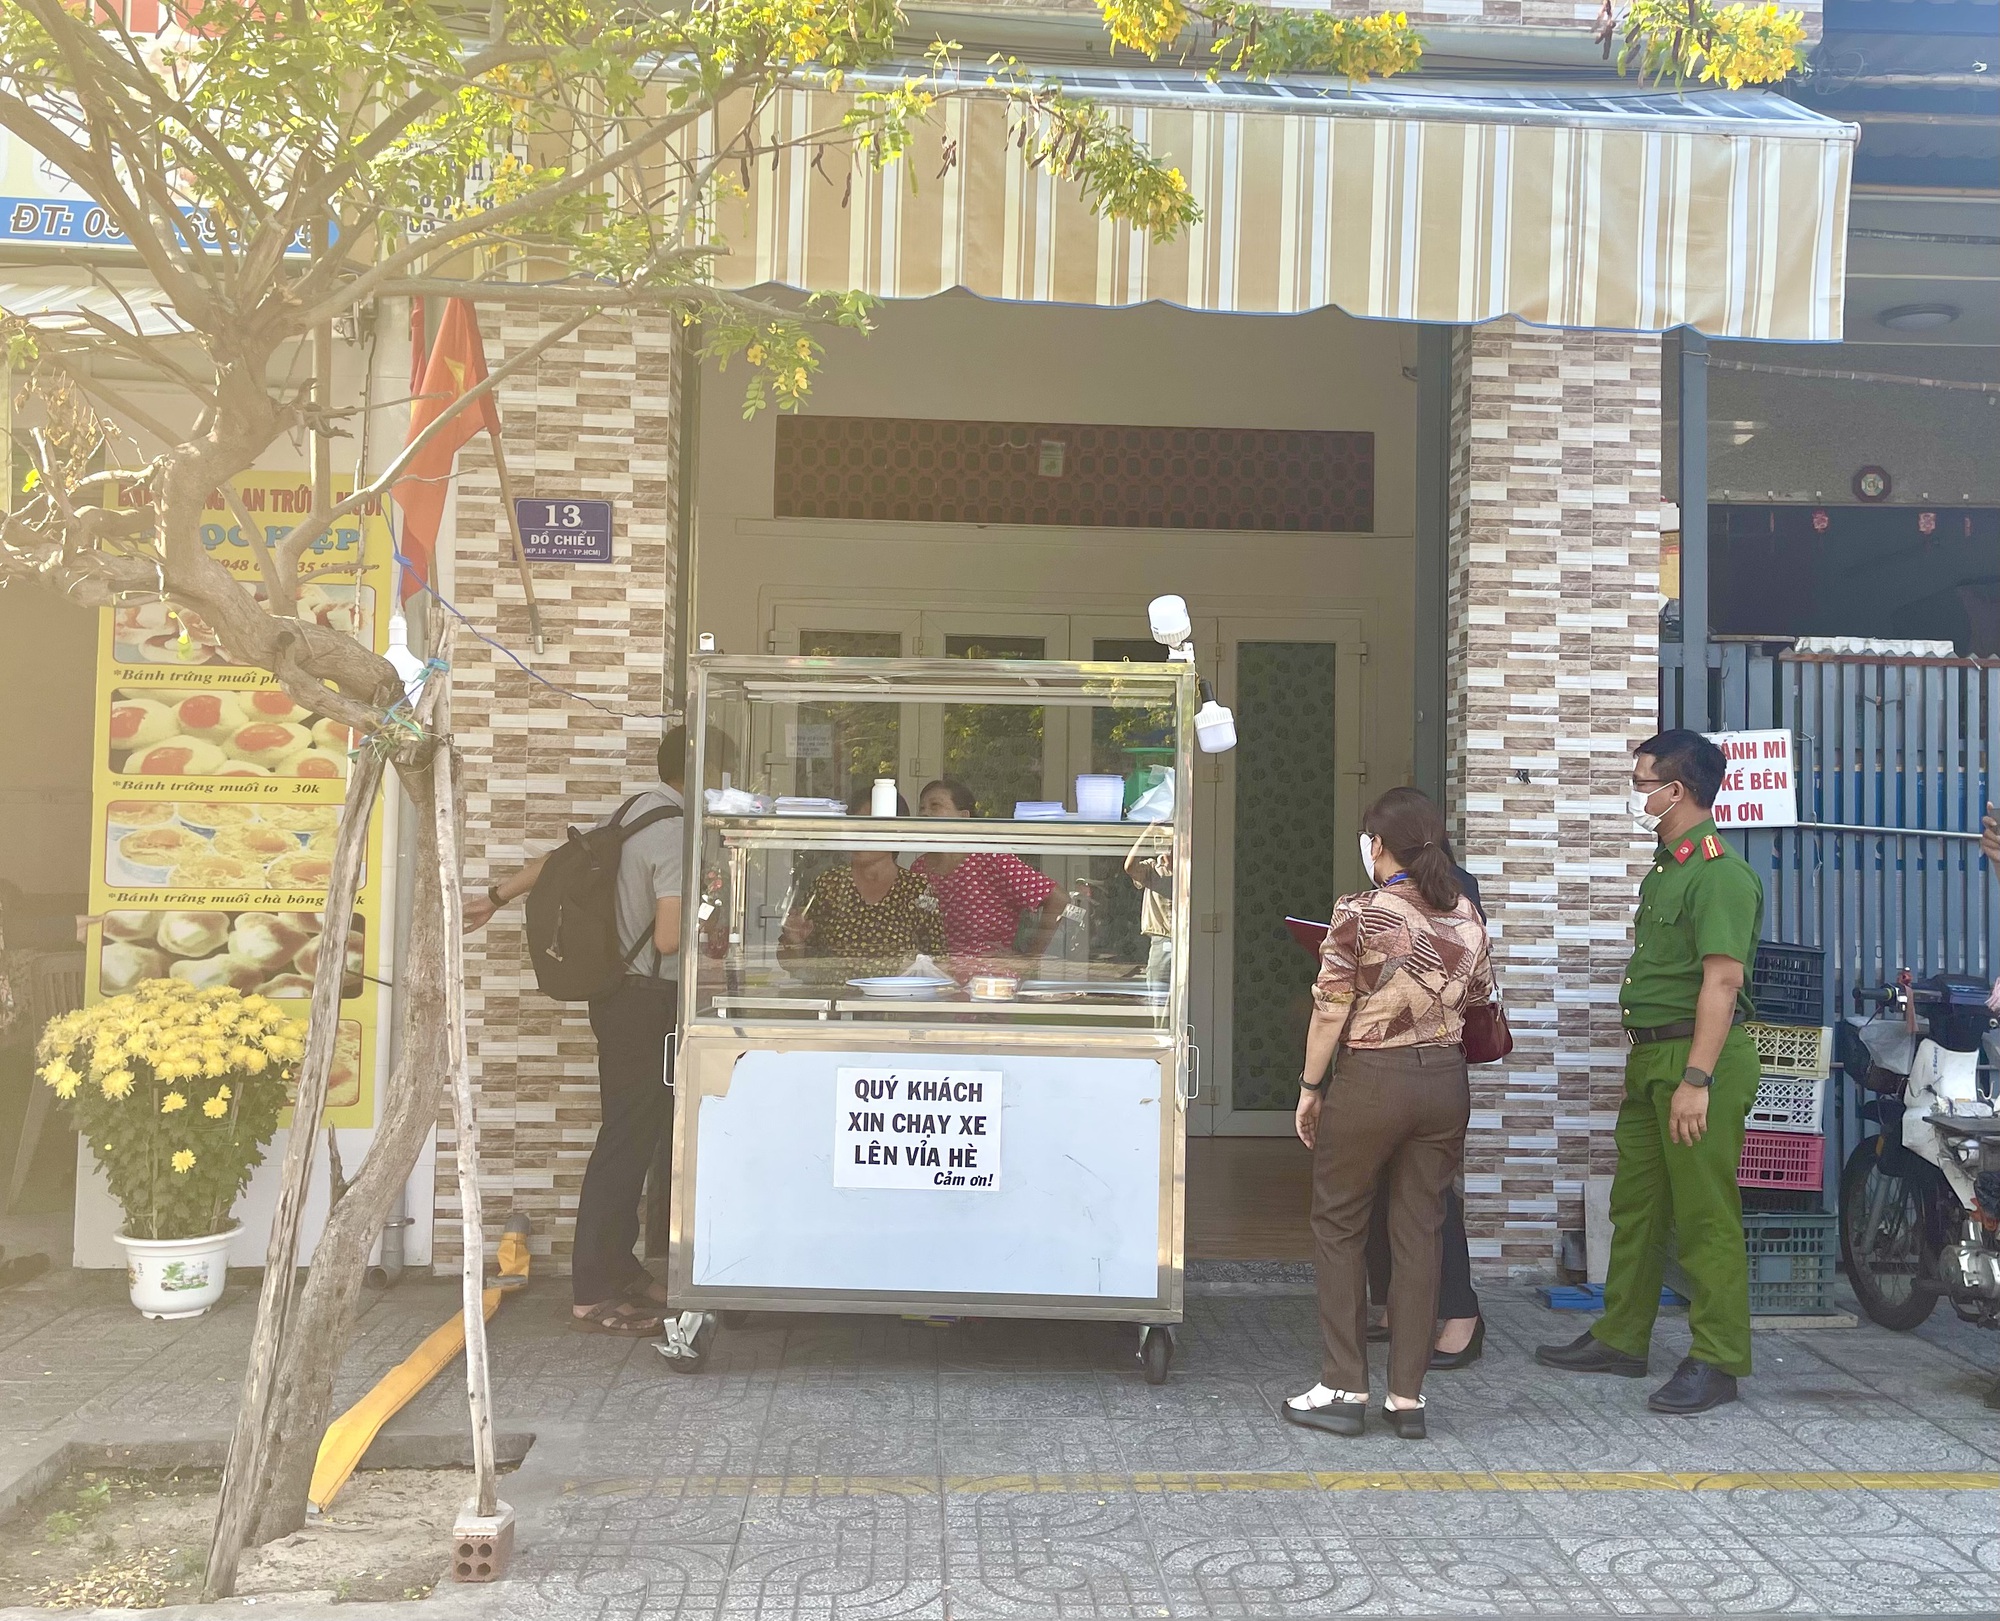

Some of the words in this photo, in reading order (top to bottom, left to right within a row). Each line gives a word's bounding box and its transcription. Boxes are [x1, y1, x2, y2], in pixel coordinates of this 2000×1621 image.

[10, 203, 75, 237] ĐT:
[545, 504, 582, 528] 13
[554, 530, 596, 546] CHIỂU
[170, 671, 213, 685] trứng
[217, 671, 257, 683] muối
[1721, 739, 1758, 760] ÁNH
[1763, 737, 1787, 759] MÌ
[170, 782, 214, 794] trứng
[263, 784, 278, 793] to
[292, 784, 320, 794] 30k
[1721, 767, 1744, 791] KẾ
[1750, 768, 1788, 790] BÊN
[1737, 802, 1764, 821] ƠN
[163, 893, 207, 905] trứng
[254, 894, 282, 904] chà
[286, 894, 325, 907] bông
[854, 1074, 899, 1103] QUÝ
[907, 1076, 983, 1103] KHÁCH
[848, 1111, 885, 1133] XIN
[892, 1113, 951, 1138] CHẠY
[958, 1115, 987, 1136] XE
[854, 1140, 898, 1166] LÊN
[905, 1139, 941, 1167] VỈA
[948, 1143, 978, 1168] HÈ
[933, 1171, 965, 1186] Cảm
[969, 1173, 994, 1187] ơn!
